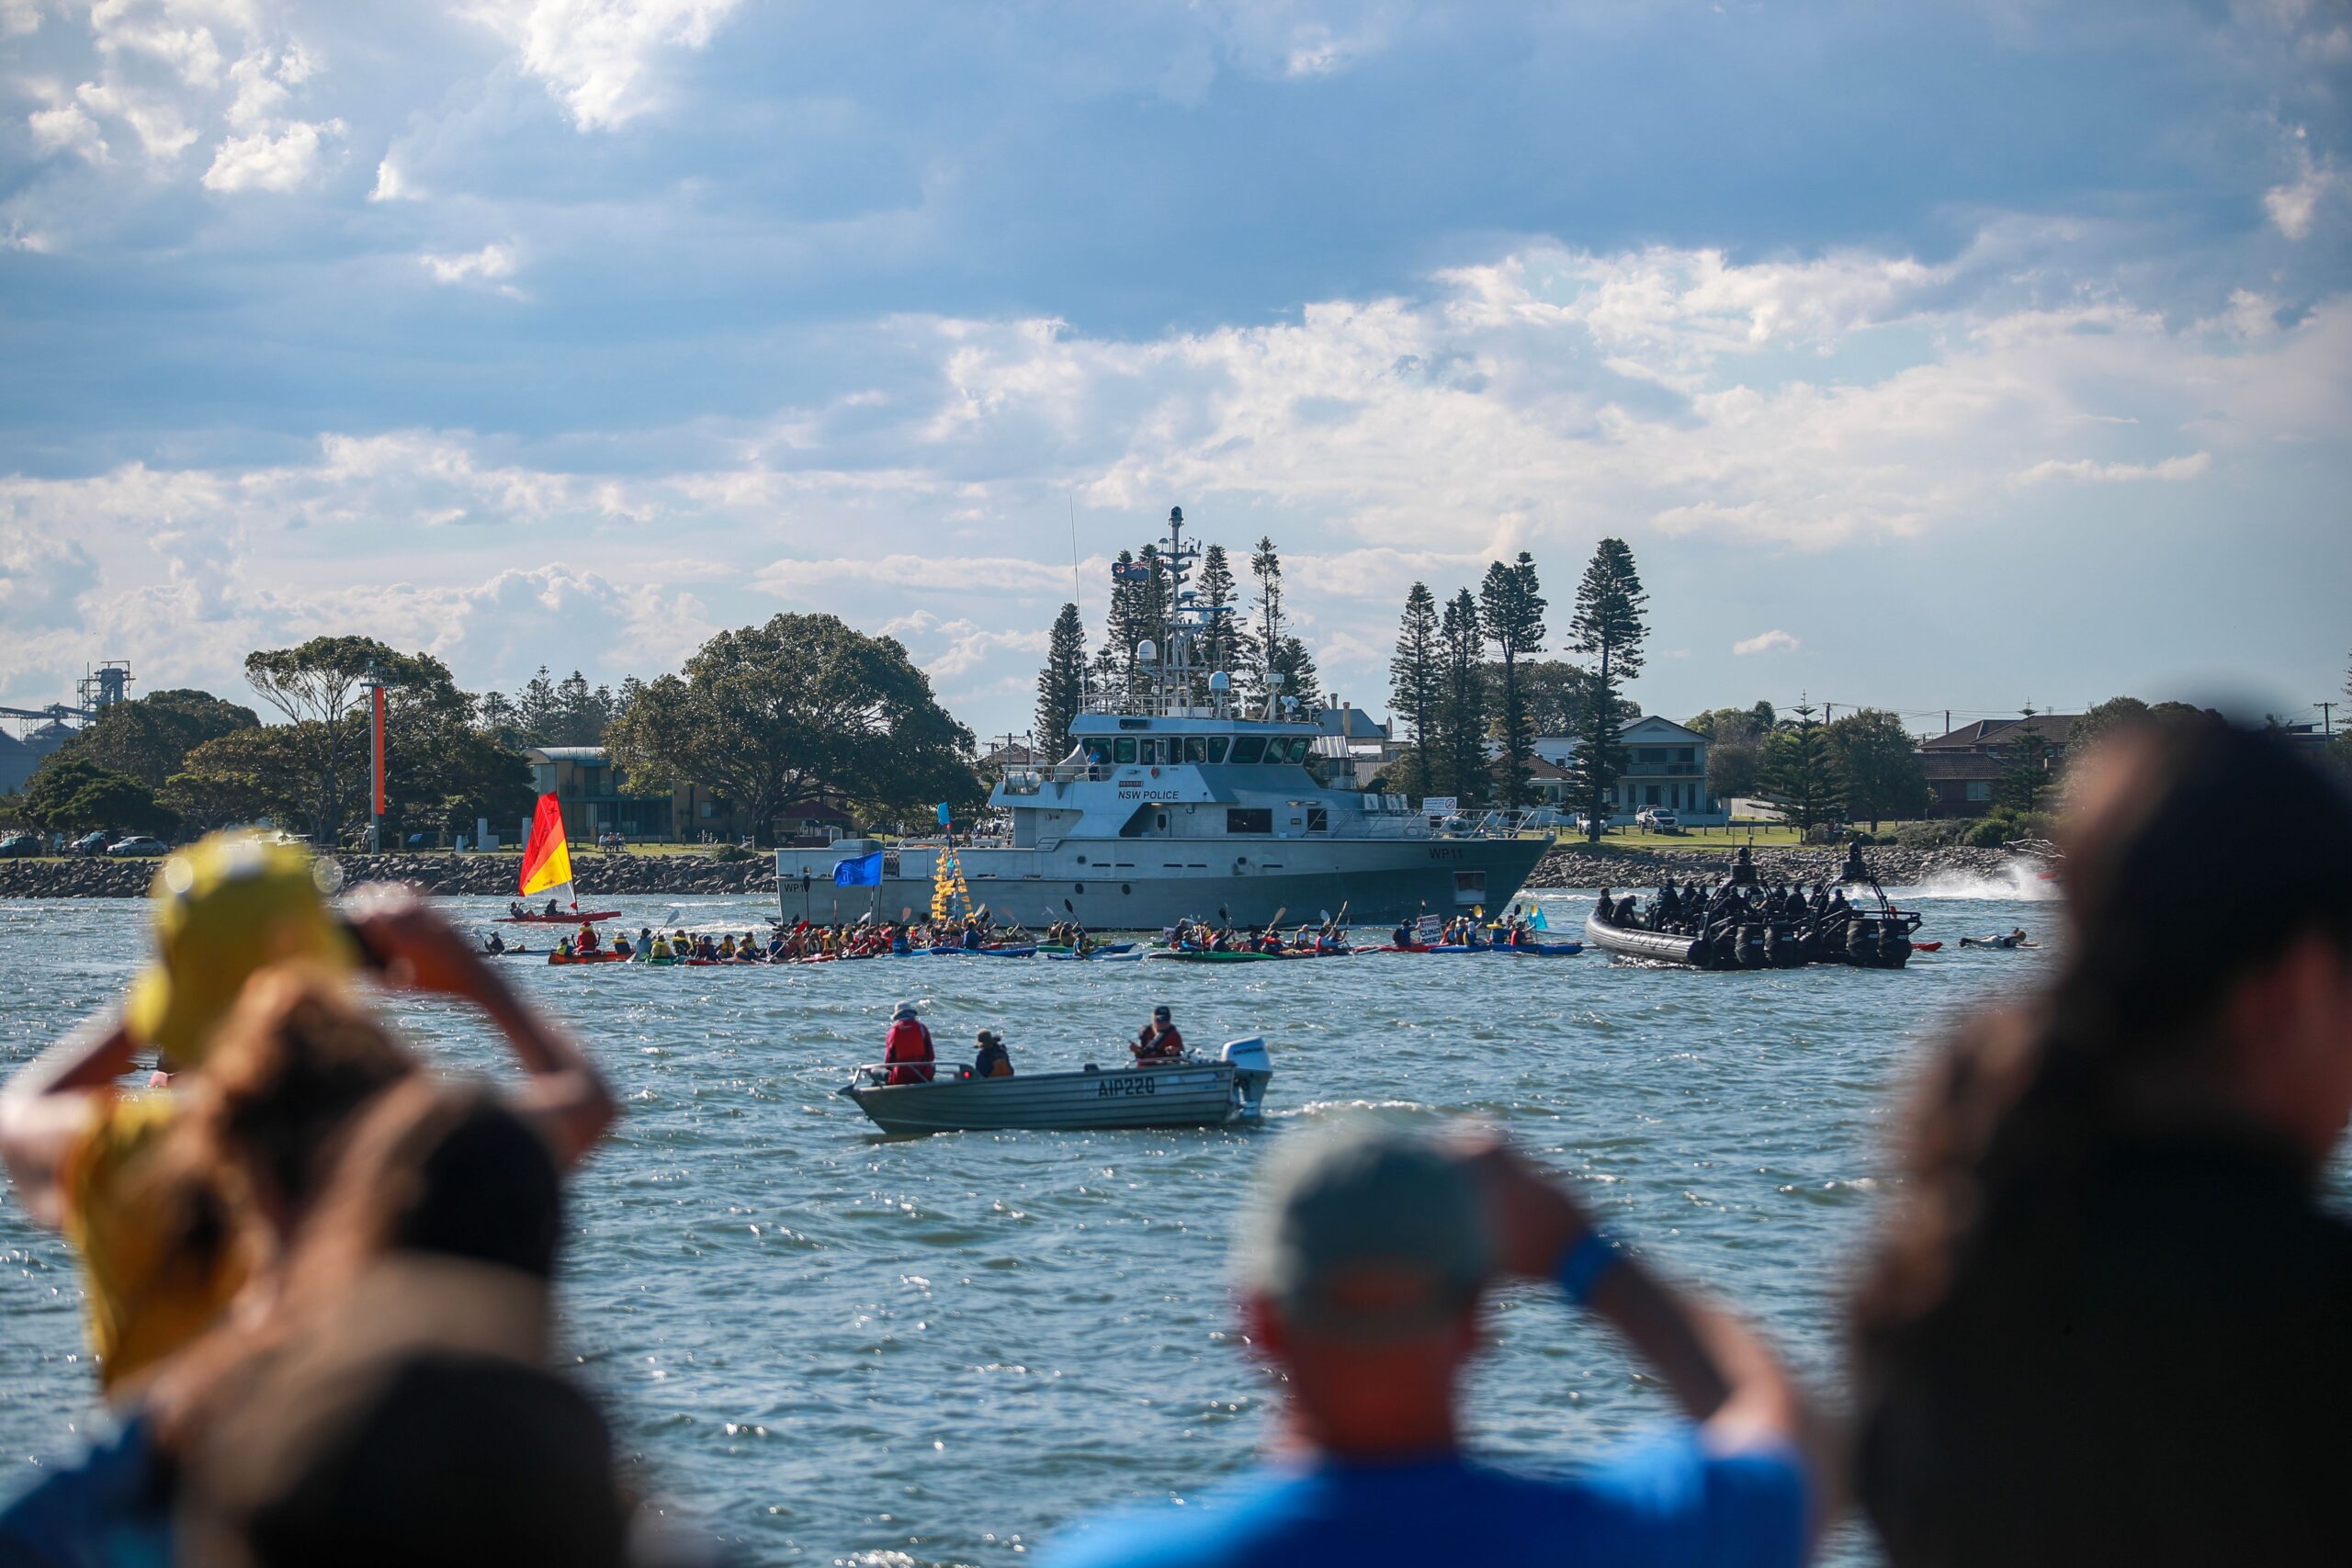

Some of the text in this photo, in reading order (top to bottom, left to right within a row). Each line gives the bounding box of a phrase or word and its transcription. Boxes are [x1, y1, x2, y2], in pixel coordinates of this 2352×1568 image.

[1118, 791, 1179, 799] NSW POLICE
[1429, 848, 1463, 860] WP11
[784, 883, 807, 892] WP1
[1098, 1077, 1155, 1097] AIP220
